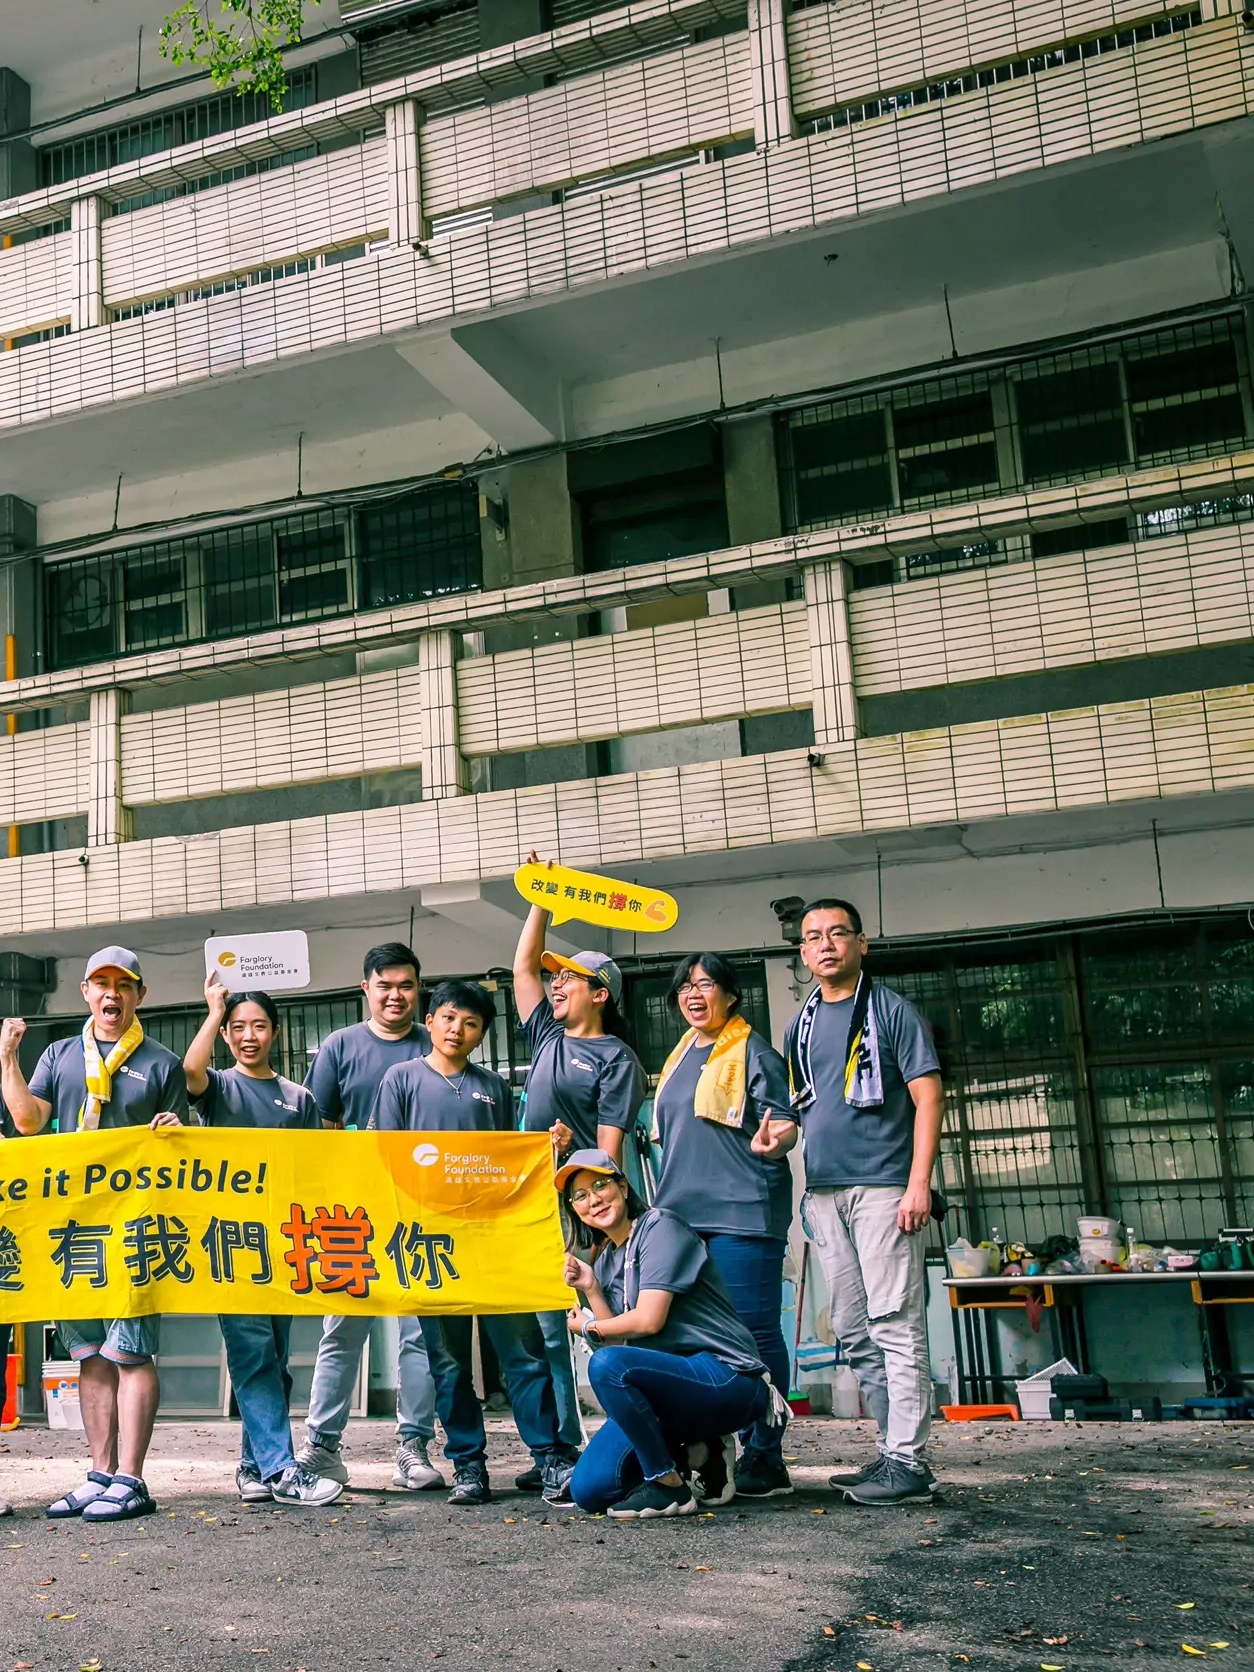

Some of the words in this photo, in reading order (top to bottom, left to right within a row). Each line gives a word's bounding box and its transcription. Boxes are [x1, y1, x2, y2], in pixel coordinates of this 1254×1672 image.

[531, 878, 559, 895] 改變
[240, 955, 273, 965] Farglory
[240, 962, 284, 972] Foundation
[444, 1152, 490, 1165] Farglory
[444, 1164, 506, 1174] Foundation
[43, 1168, 70, 1198] it
[84, 1160, 267, 1194] Possible!
[48, 1203, 460, 1299] 有我們撐你
